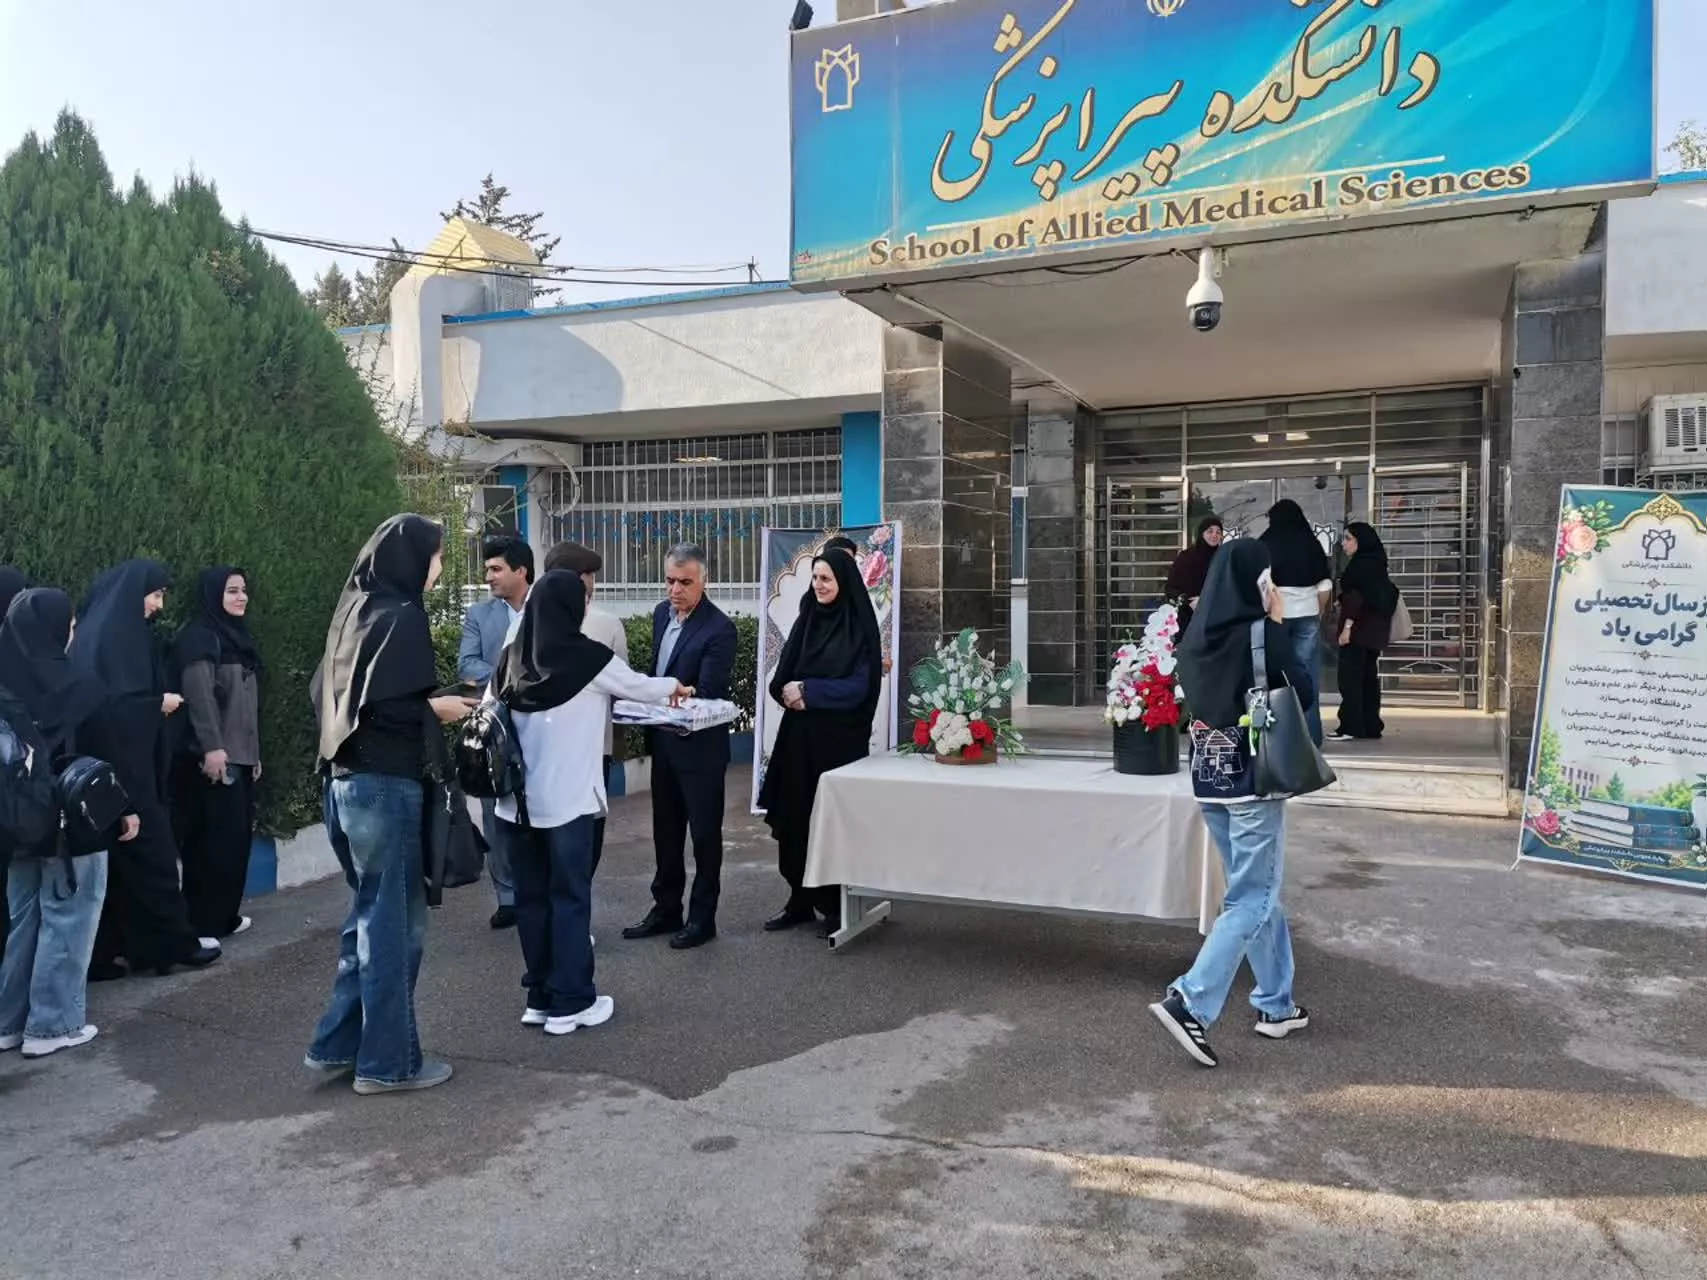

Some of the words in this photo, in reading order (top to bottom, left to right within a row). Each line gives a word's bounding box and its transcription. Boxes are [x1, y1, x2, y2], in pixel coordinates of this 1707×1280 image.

[1201, 0, 1440, 136] دانشکده
[931, 0, 1184, 203] پیراپزشکی
[868, 226, 981, 266] School
[992, 219, 1034, 251] of
[1040, 208, 1148, 246] Allied
[1164, 179, 1326, 230] Medical
[1338, 162, 1529, 207] Sciences
[1574, 588, 1652, 613] تحصیلی
[1653, 592, 1698, 616] سال
[1601, 617, 1631, 642] باد
[1634, 620, 1698, 647] گرامی
[1649, 697, 1681, 707] دانشگاه
